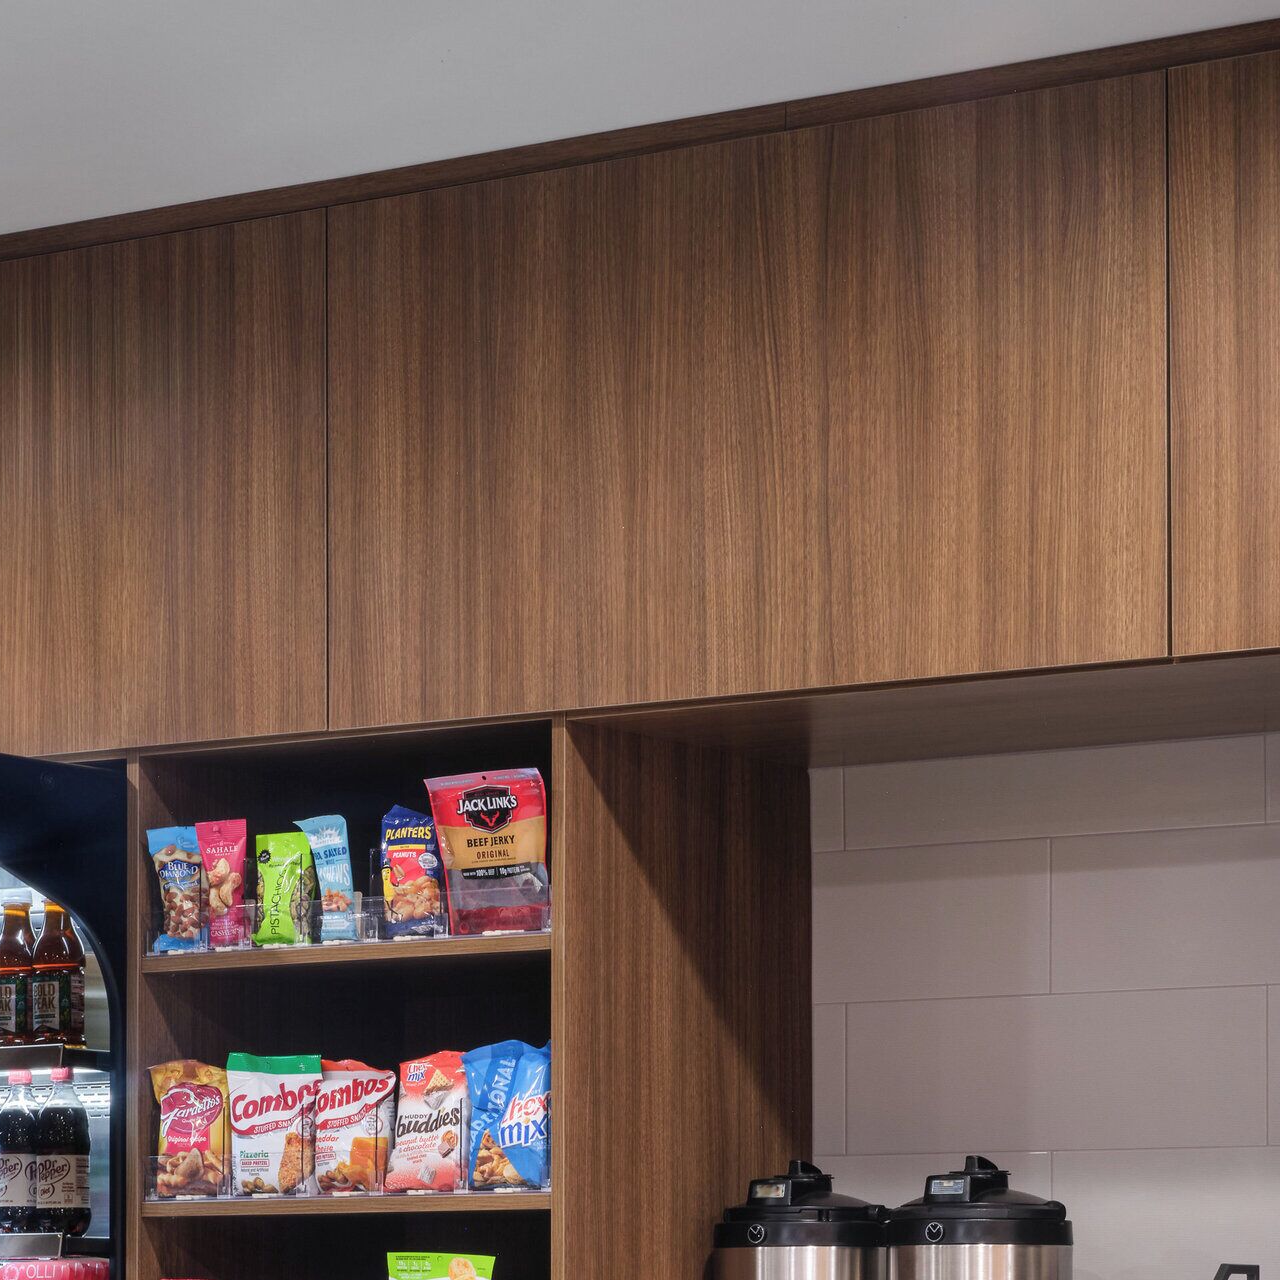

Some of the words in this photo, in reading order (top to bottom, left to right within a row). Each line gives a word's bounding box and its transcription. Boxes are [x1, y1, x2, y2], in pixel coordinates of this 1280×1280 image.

[457, 799, 487, 814] JACK
[487, 795, 517, 810] LINK'S
[385, 826, 432, 841] PLANTERS
[466, 837, 488, 848] BEEF
[490, 835, 515, 845] JERKY
[476, 850, 510, 859] ORIGINAL
[167, 862, 188, 871] BLUE
[33, 984, 53, 998] GOLD
[34, 996, 53, 1009] PEAK
[396, 1108, 460, 1138] buddies
[499, 1115, 547, 1148] mix
[240, 1150, 269, 1158] Pizzeria
[45, 1160, 58, 1171] Dr
[38, 1165, 68, 1182] Pepper
[26, 1264, 56, 1279] OLLI
